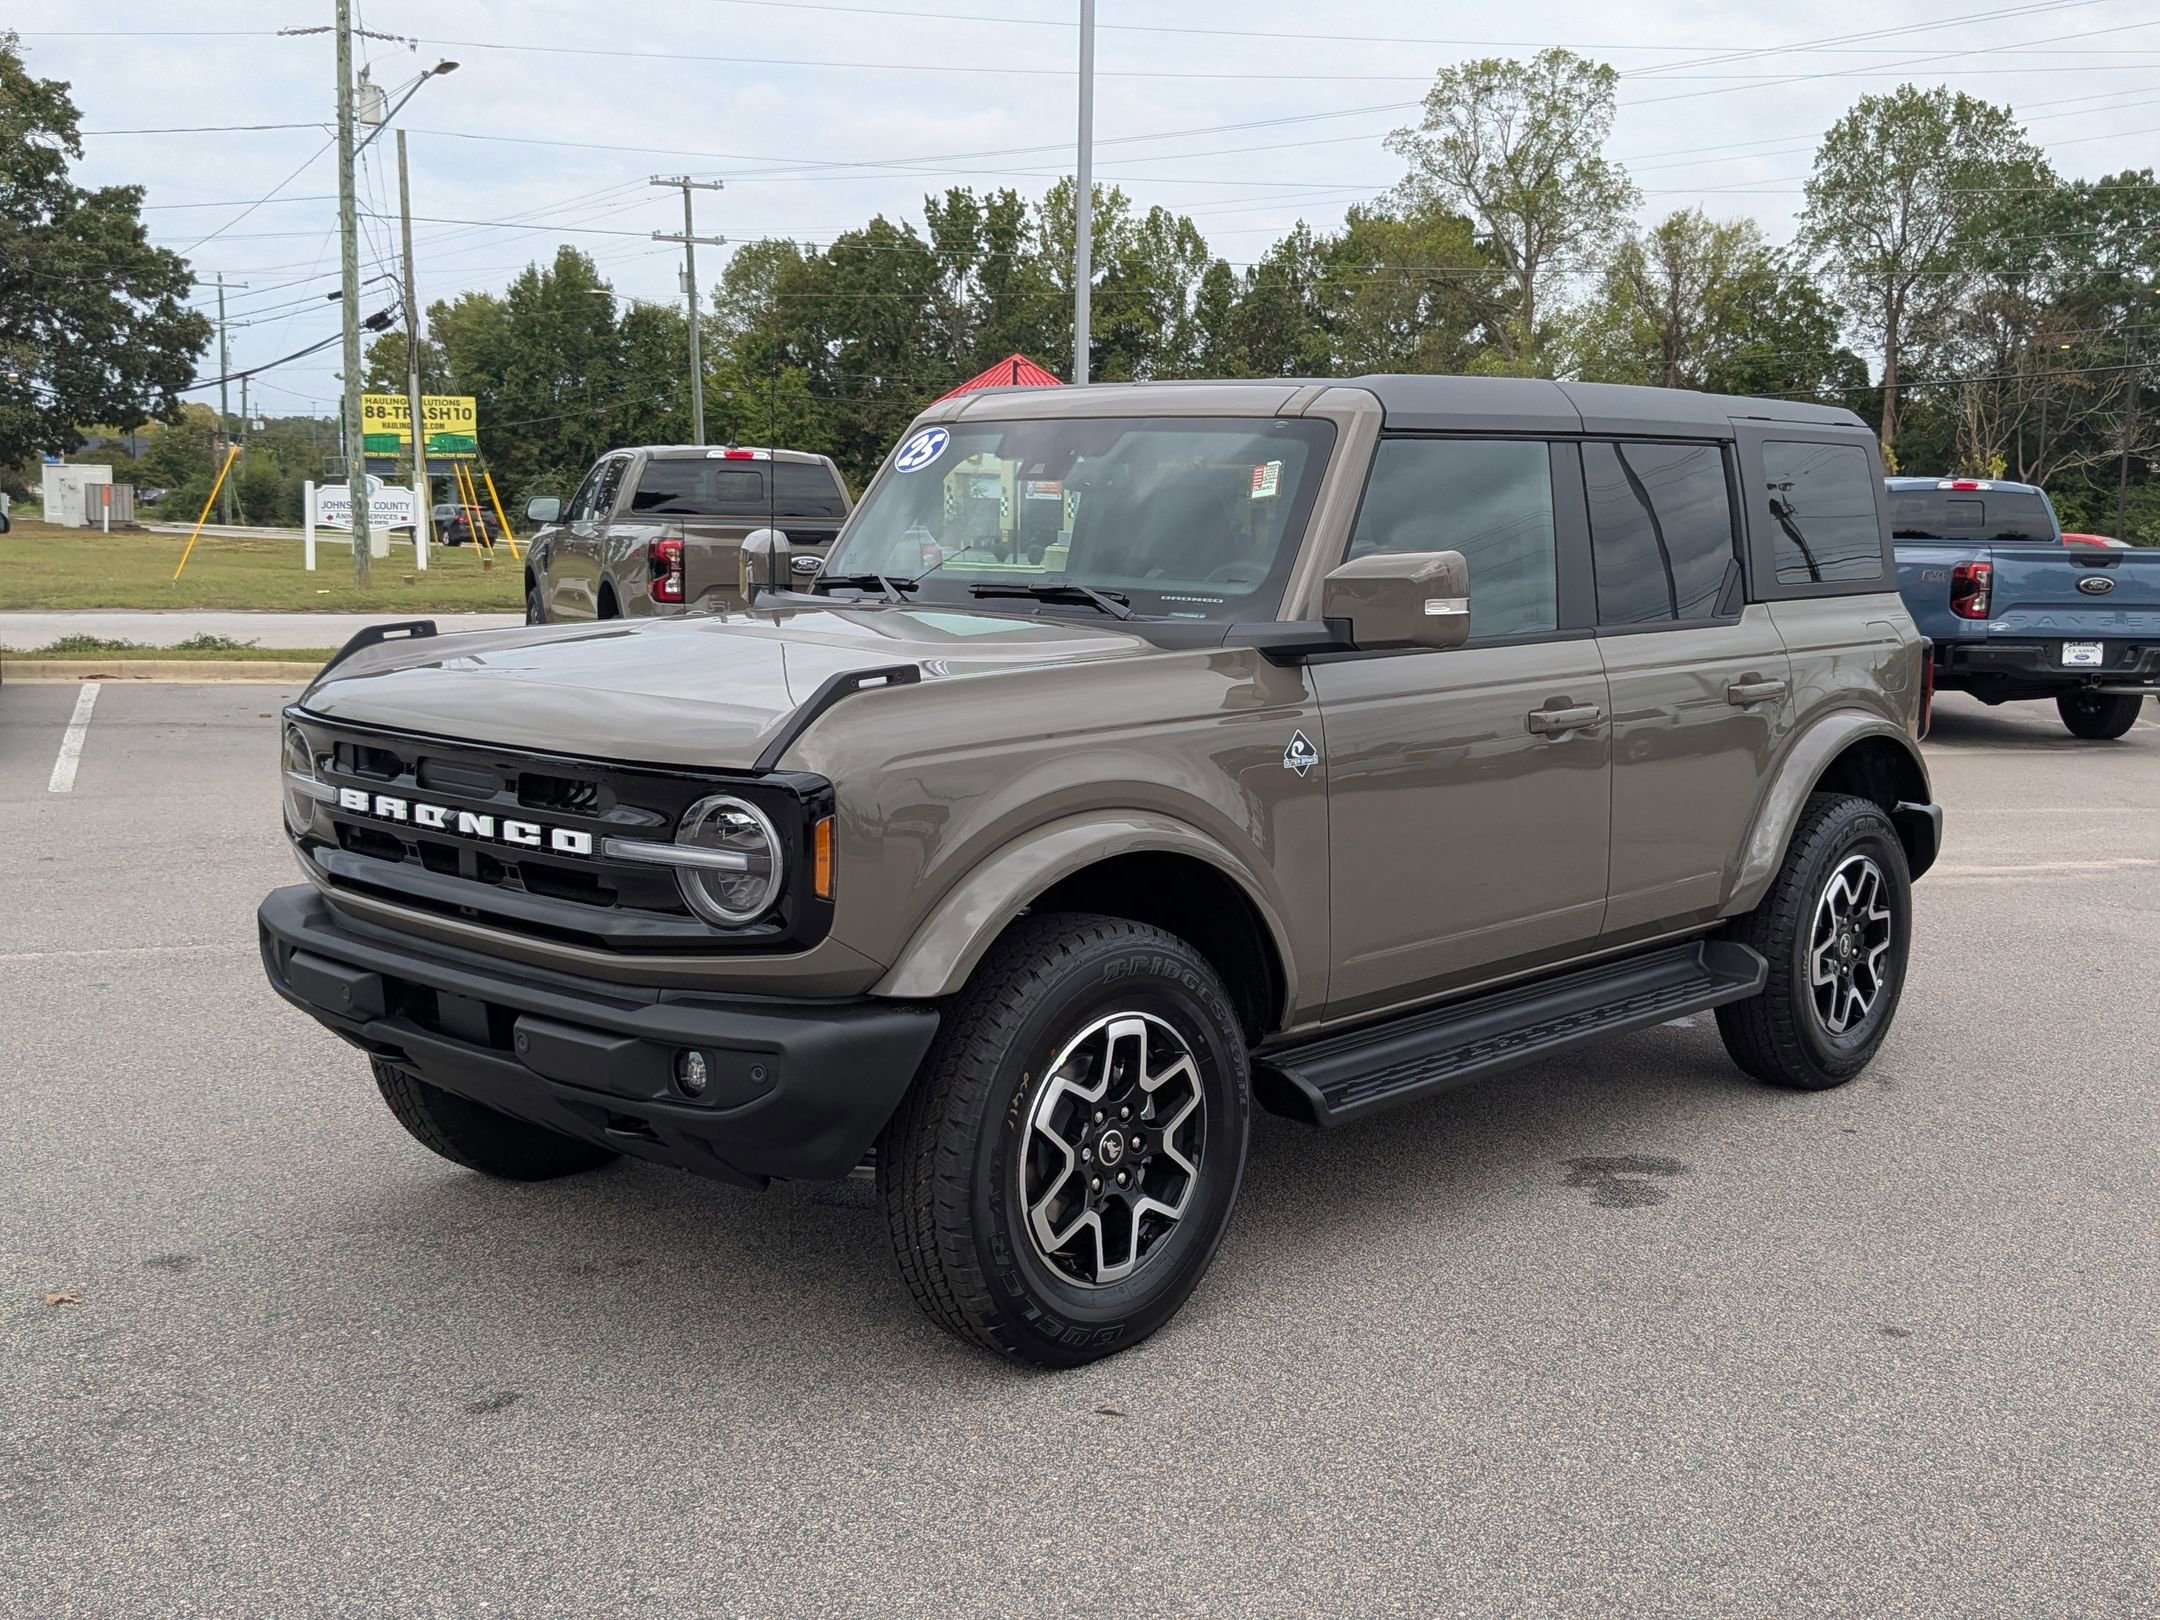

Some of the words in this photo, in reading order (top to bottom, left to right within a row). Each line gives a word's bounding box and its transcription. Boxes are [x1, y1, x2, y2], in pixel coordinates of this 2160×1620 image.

[364, 397, 408, 406] HAULING
[422, 399, 461, 407] LUTIONS
[897, 433, 946, 467] 25
[321, 500, 369, 509] JOHNS
[373, 501, 411, 510] COUNTY
[340, 787, 592, 855] BRONCO
[1102, 954, 1250, 1106] BRIDGESTONE
[989, 1231, 1126, 1346] DUELER
